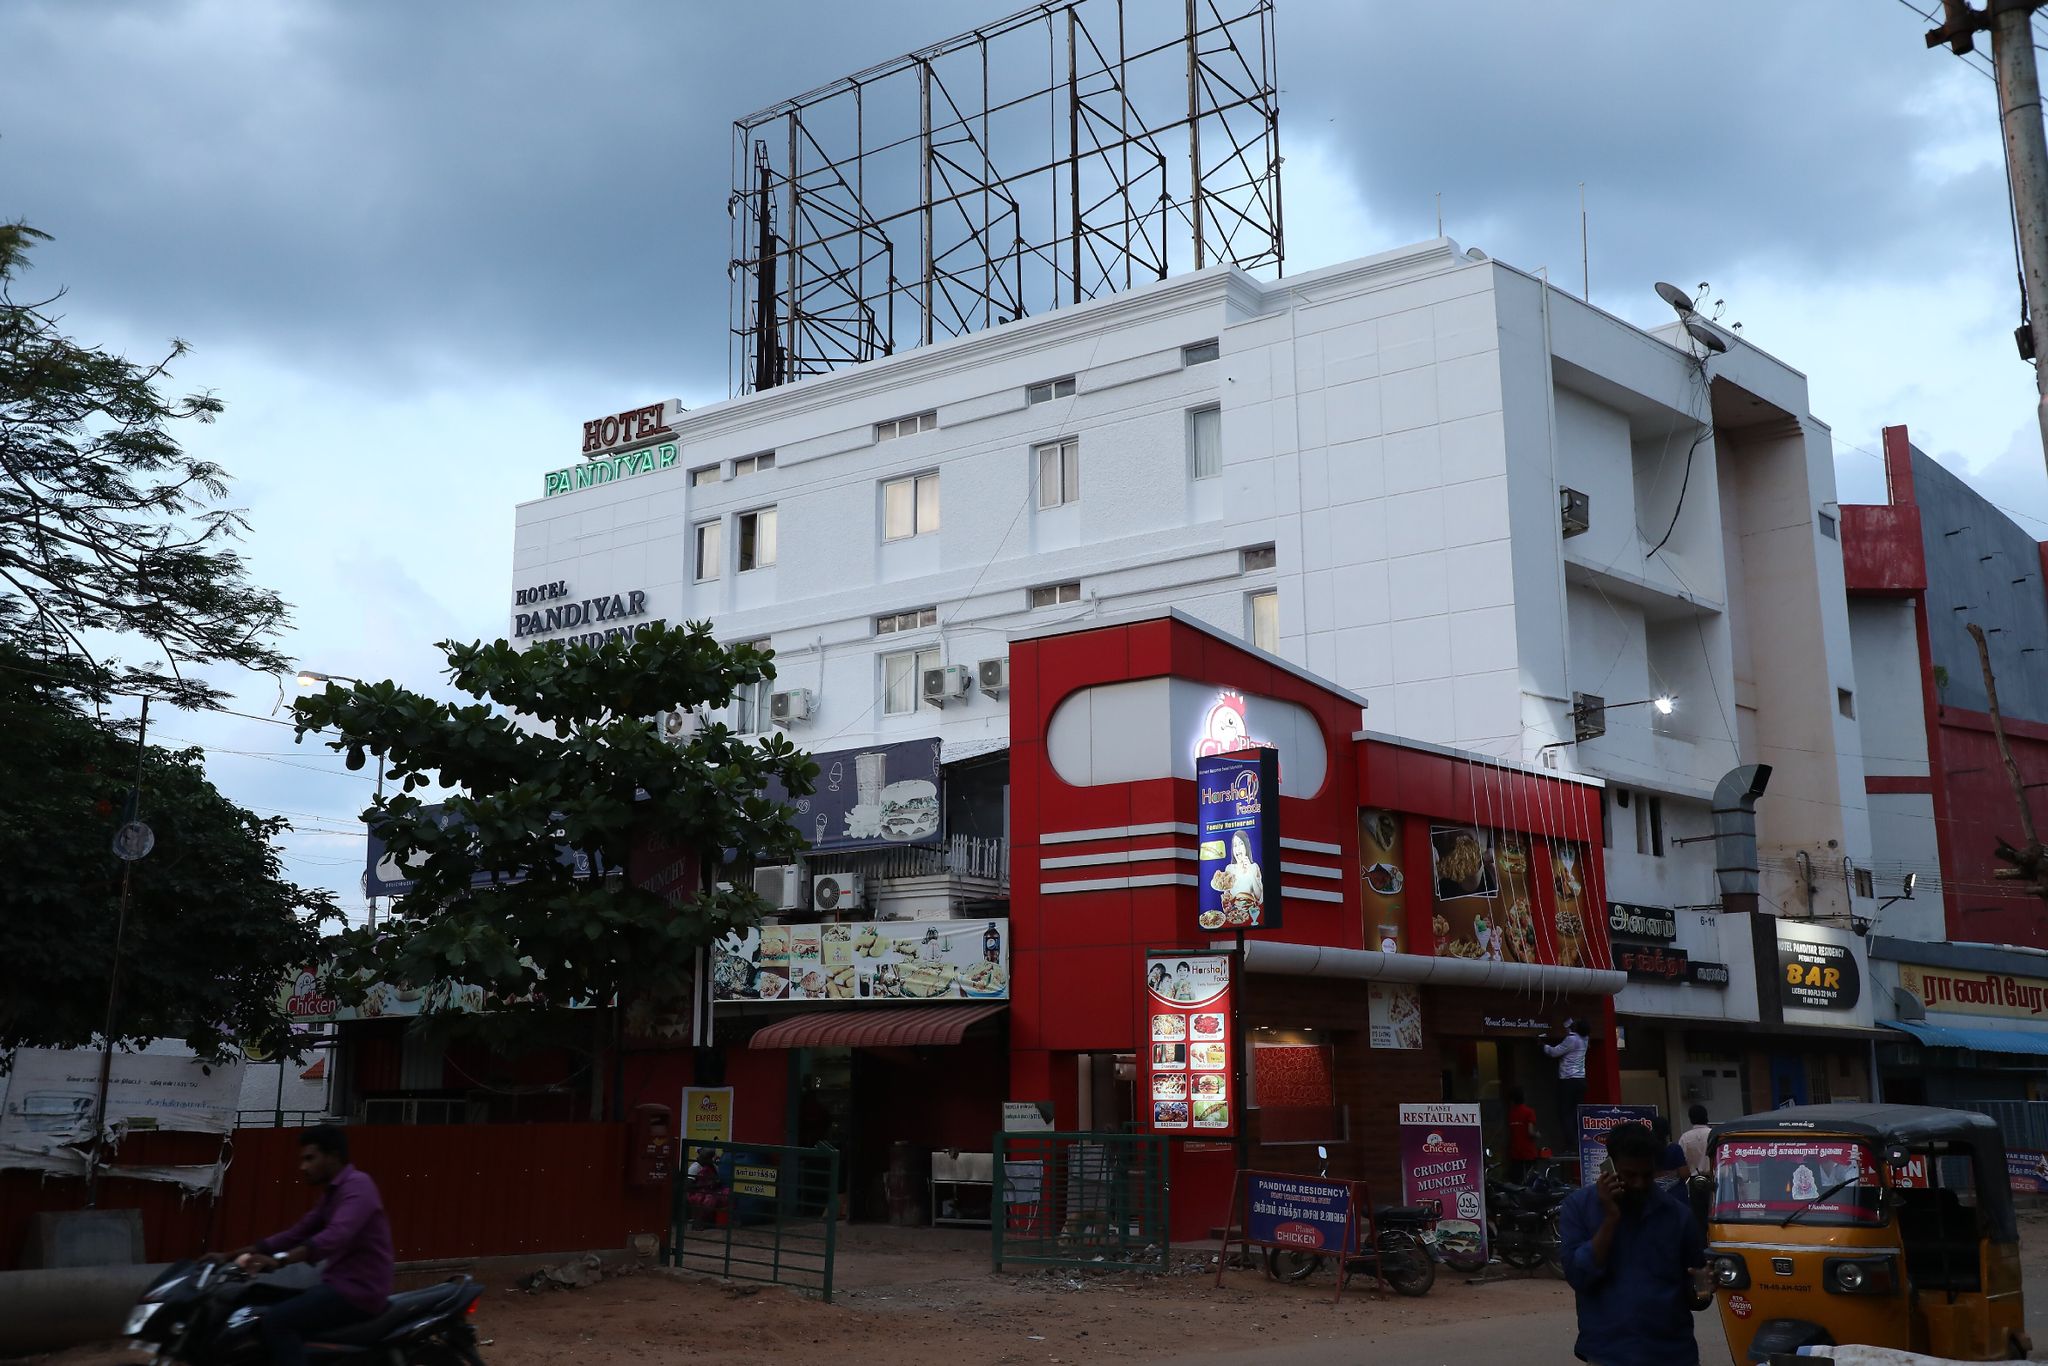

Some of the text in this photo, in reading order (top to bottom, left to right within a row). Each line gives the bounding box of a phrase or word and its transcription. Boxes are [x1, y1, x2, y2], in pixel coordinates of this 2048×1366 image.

[583, 403, 672, 451] HOTEL
[545, 442, 678, 496] PANDIYAR
[516, 580, 568, 606] HOTEL
[515, 590, 646, 637] PANDIYAR
[1236, 799, 1261, 815] Foods
[1224, 818, 1255, 829] Restaurant
[1793, 943, 1817, 956] PANDIYAR
[1818, 946, 1844, 958] RESIDENCY
[1786, 963, 1840, 990] BAR
[287, 997, 336, 1014] Chicken
[1403, 1112, 1476, 1123] RESTAURANT
[1422, 1144, 1458, 1153] Chicken
[1413, 1158, 1467, 1178] CRUNCHY
[1259, 1181, 1296, 1193] PANDIYAR
[1299, 1186, 1344, 1198] RESIDENCY
[1417, 1173, 1467, 1191] MUNCHY
[1440, 1185, 1474, 1195] RESTAURANT
[1320, 1210, 1347, 1224] உணவக
[1296, 1224, 1315, 1234] Planet
[1277, 1231, 1316, 1244] CHICKEN
[1776, 1263, 1790, 1272] RE
